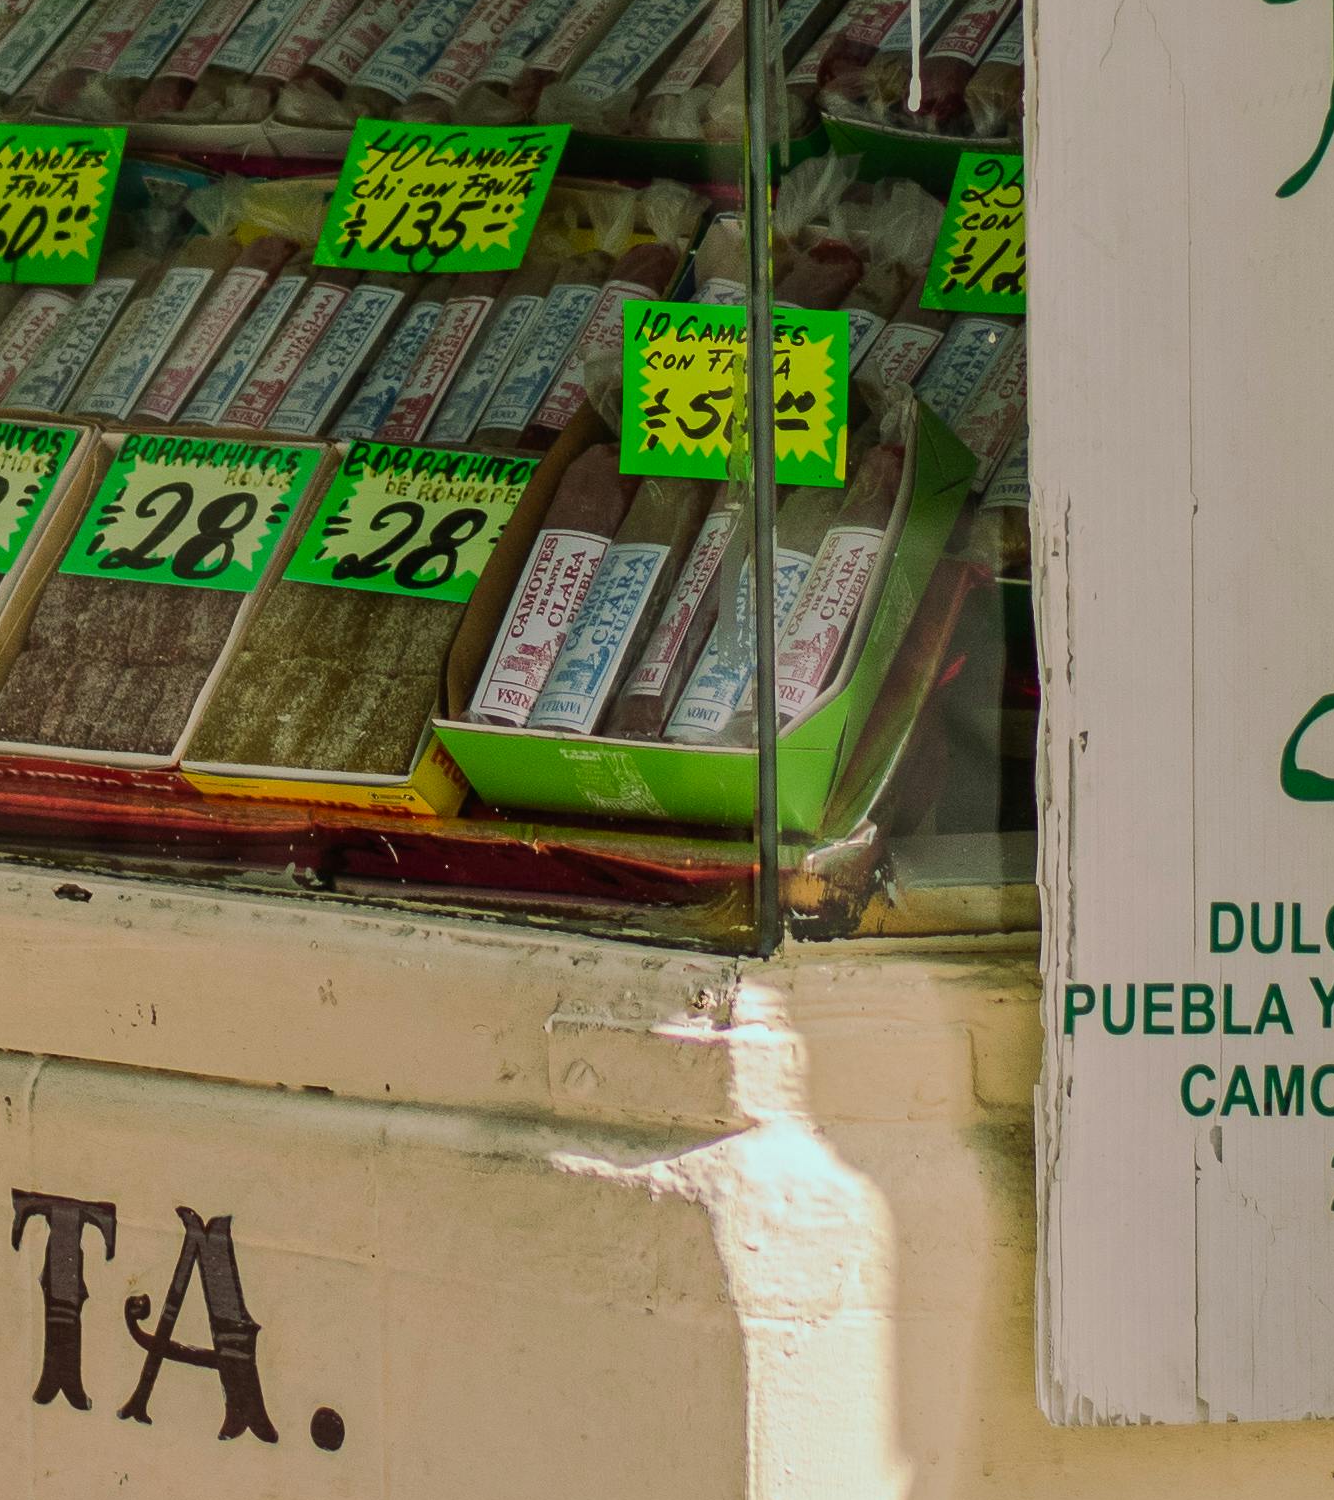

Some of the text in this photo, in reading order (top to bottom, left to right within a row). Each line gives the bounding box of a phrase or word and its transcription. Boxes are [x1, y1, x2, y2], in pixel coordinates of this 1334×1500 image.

[3, 172, 80, 200] FRUTA
[408, 181, 457, 198] CON
[460, 168, 539, 199] FRUTA
[426, 132, 553, 167] CAMOTES
[962, 212, 1024, 230] CON
[1, 301, 55, 363] CLARA
[56, 285, 112, 366] CLARA
[71, 287, 123, 367] PUEBLA
[273, 291, 334, 374] SANTA CLARA
[326, 293, 378, 368] CLARA
[337, 296, 387, 368] PUEBLA
[381, 306, 431, 381] CLARA
[474, 300, 523, 376] CLARA
[536, 286, 587, 363] CLARA
[647, 351, 695, 370] CON
[931, 324, 990, 407] CLARA
[117, 434, 302, 477] BORRACHITOS
[385, 480, 412, 496] DE
[510, 536, 559, 639] CAMOTES
[536, 557, 565, 617] DE SANTA
[547, 550, 586, 628] CLARA
[567, 556, 601, 624] PUEBLA
[677, 528, 719, 603] CLARA
[692, 528, 730, 595] PUEBLA
[787, 535, 841, 638] CAMOTES
[819, 545, 866, 622] CLARA
[839, 550, 879, 620] PUEBLA
[590, 554, 646, 646] CLARA
[608, 556, 655, 648] PUEBLA
[1063, 981, 1295, 1037] PUEBLA
